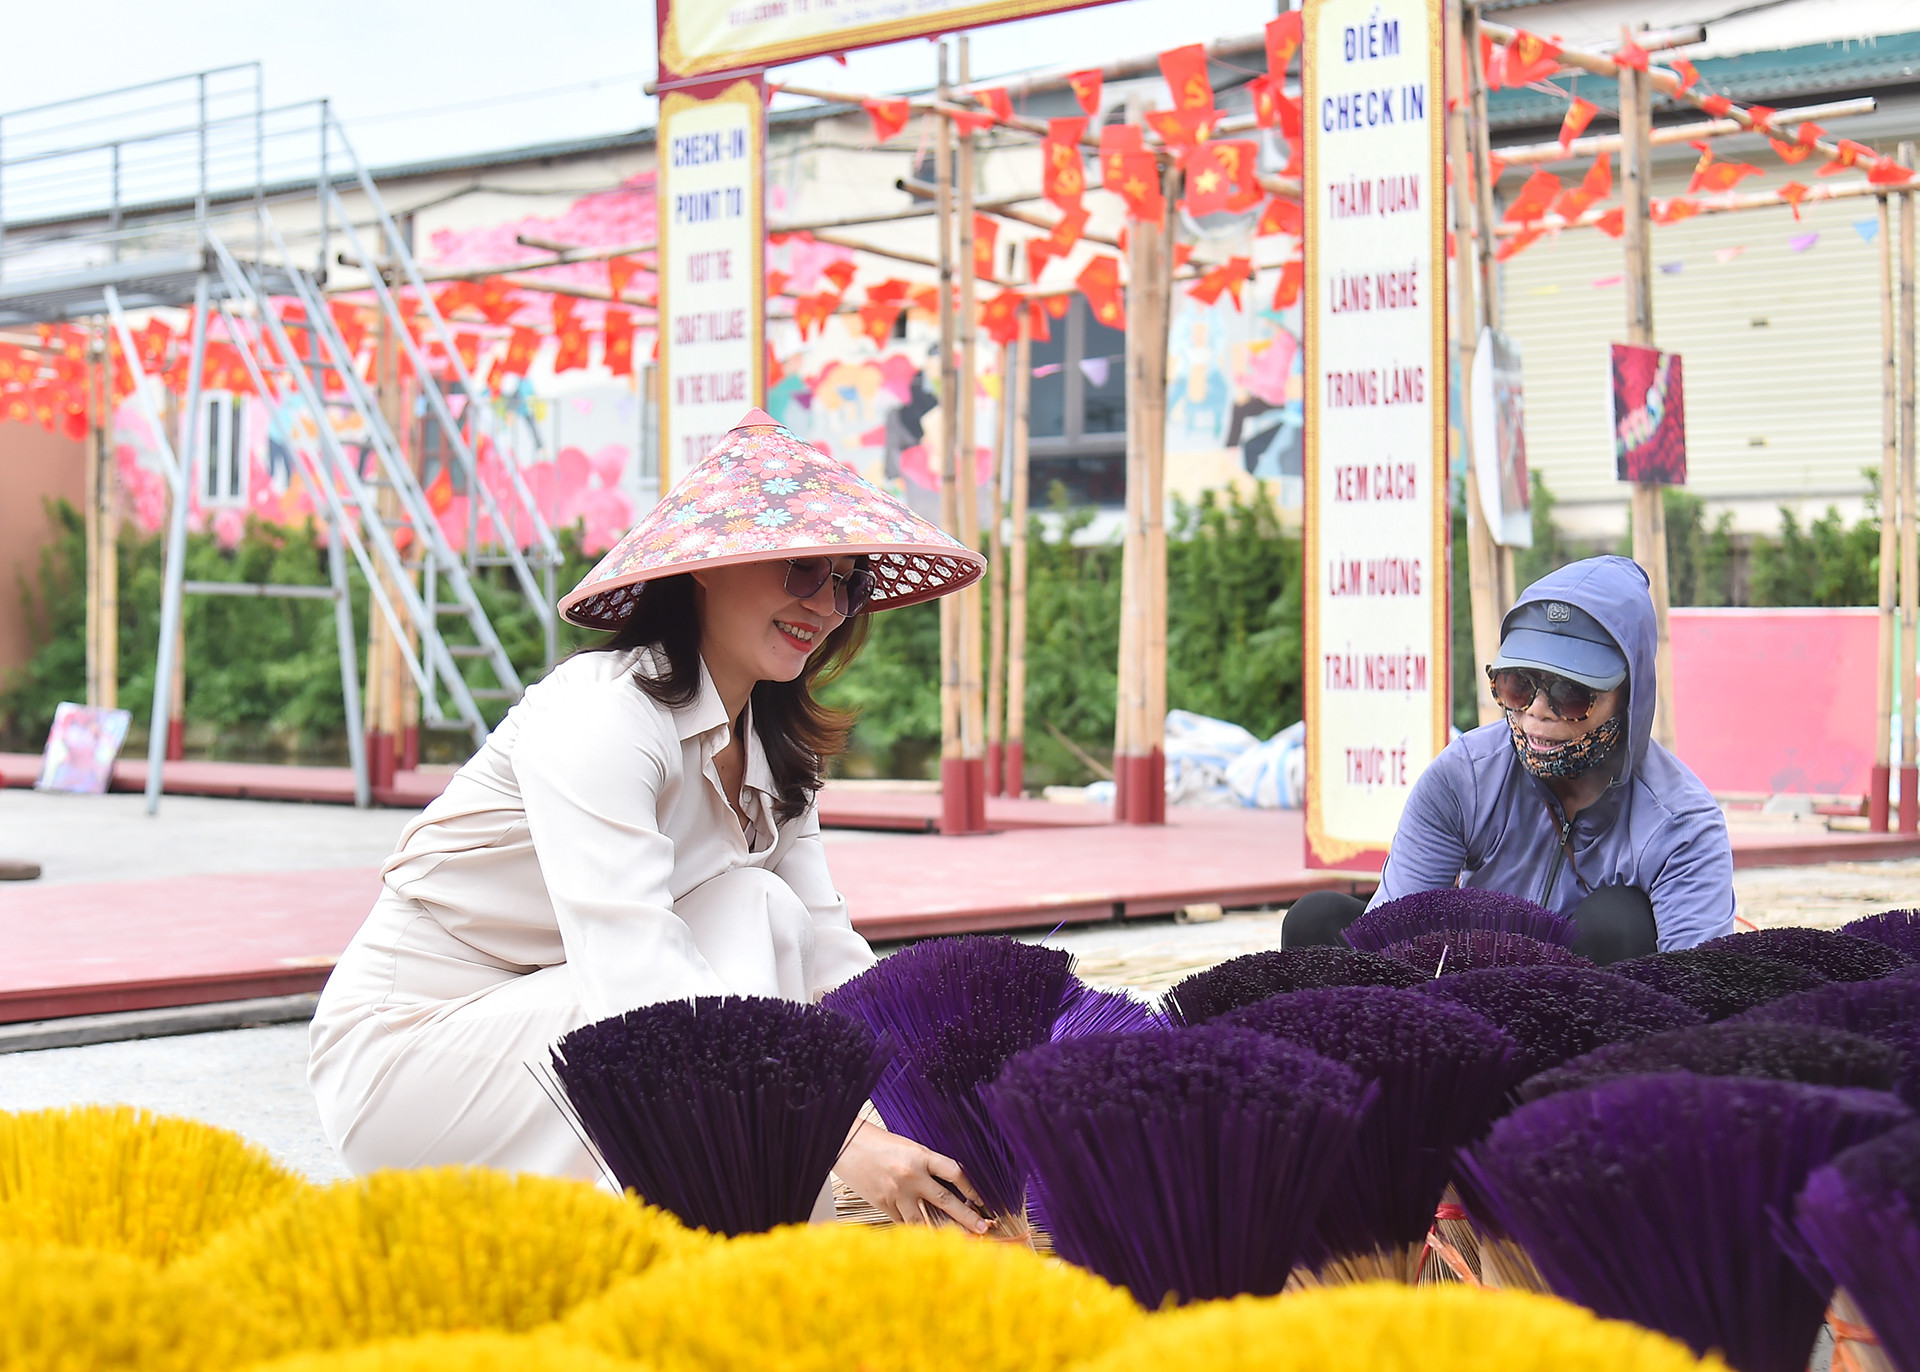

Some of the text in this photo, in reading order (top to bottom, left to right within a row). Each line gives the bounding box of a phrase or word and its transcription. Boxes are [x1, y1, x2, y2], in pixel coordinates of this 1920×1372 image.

[1345, 5, 1399, 62] ĐIỂM
[1323, 84, 1423, 131] CHECK IN
[675, 129, 744, 166] CHECK-IN
[676, 190, 720, 223] POINT
[1377, 174, 1419, 217] QUAN
[1327, 370, 1377, 408] TRONG
[1335, 464, 1368, 501] XEM
[1366, 555, 1421, 596] HƯƠNG
[1364, 643, 1426, 701] NGHIỆM
[1346, 734, 1408, 795] THỰC TẾ
